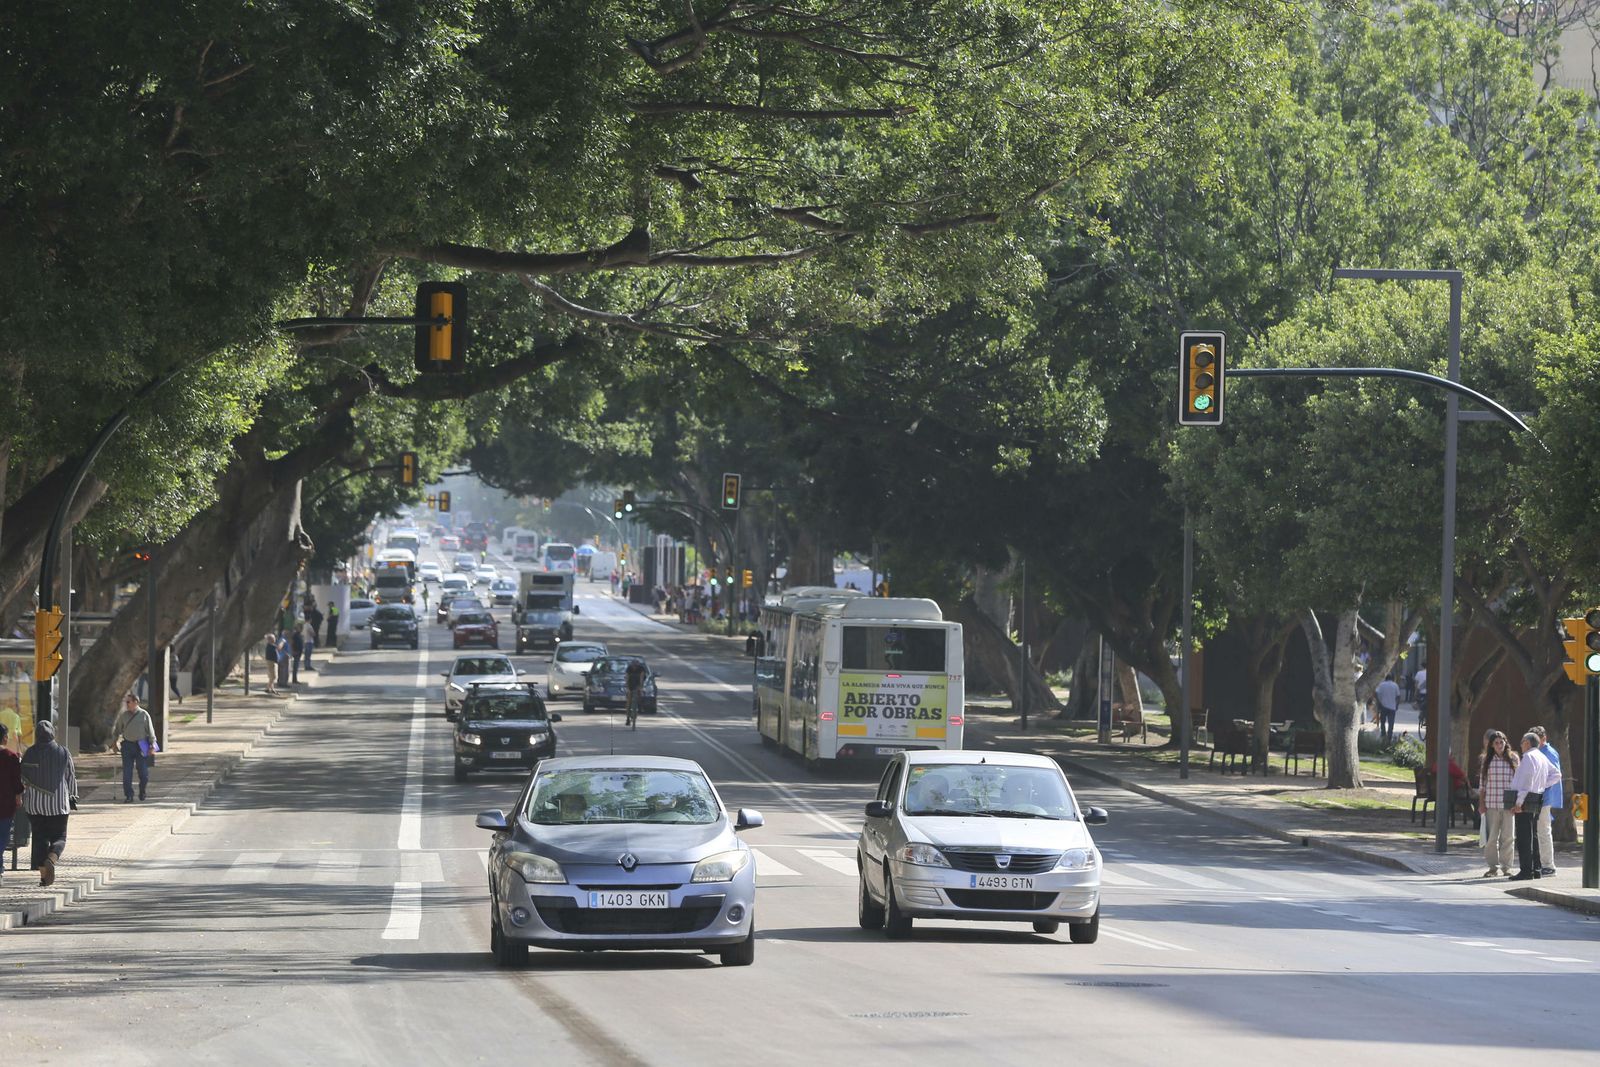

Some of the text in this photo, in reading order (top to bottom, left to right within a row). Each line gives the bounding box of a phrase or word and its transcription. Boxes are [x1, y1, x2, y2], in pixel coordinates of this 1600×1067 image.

[844, 692, 921, 706] ABIERTO
[844, 706, 942, 720] POR OBRAS
[978, 877, 1033, 889] 4493 GTN
[600, 893, 665, 906] 1403 GKN
